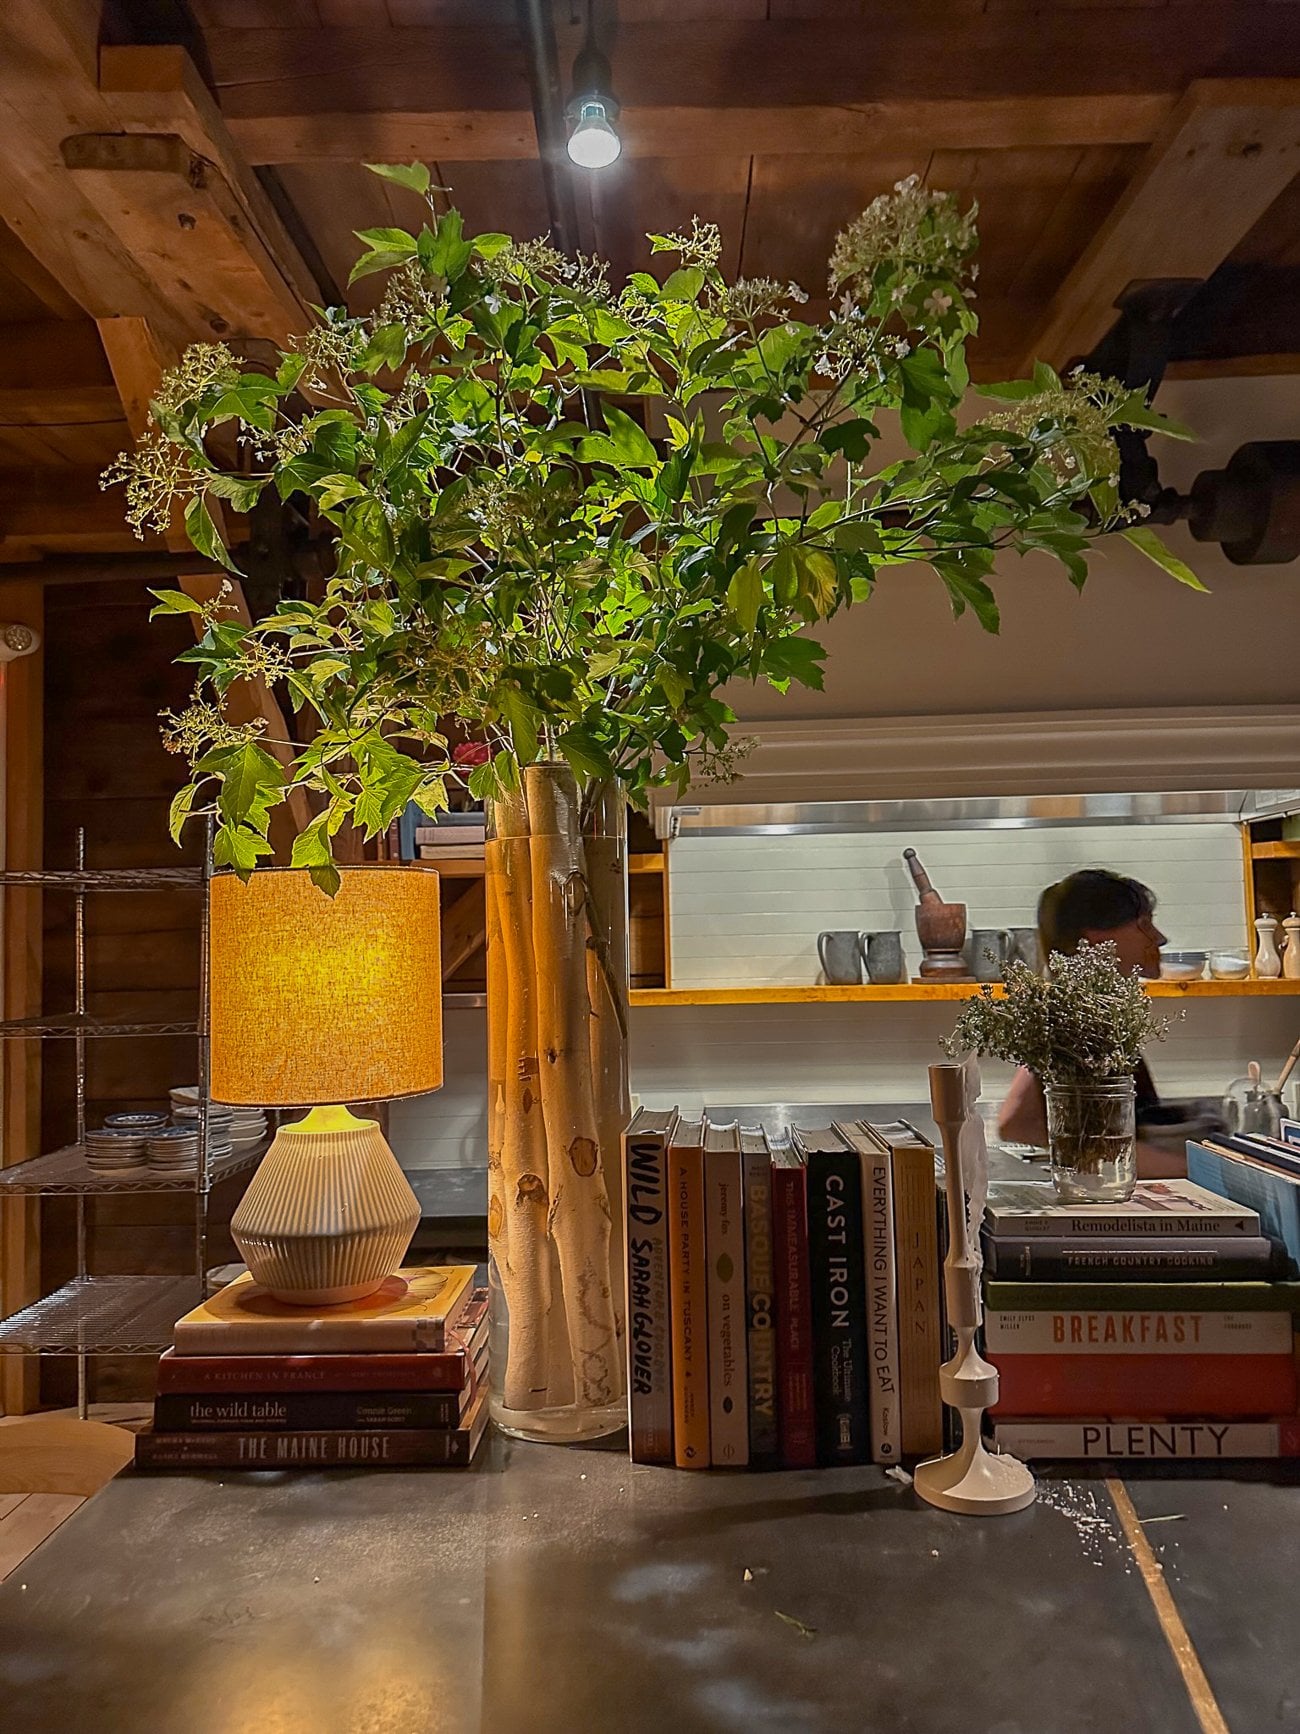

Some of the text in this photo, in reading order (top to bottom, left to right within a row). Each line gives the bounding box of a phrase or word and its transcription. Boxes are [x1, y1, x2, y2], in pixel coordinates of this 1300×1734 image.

[630, 1143, 662, 1226] WILD
[718, 1182, 730, 1236] jeremy fox
[751, 1184, 771, 1288] BASQUE
[873, 1167, 887, 1271] EVERYTHING
[1071, 1219, 1221, 1232] Remodelista in Maine
[631, 1237, 652, 1309] SARAH
[680, 1167, 693, 1363] A HOUSE PARTY IN TUSCANY
[825, 1175, 850, 1328] CAST IRON
[1068, 1256, 1214, 1266] FRENCH COUNTRY COOKING
[912, 1231, 926, 1336] JAPAN
[874, 1285, 889, 1337] WANT
[1053, 1315, 1203, 1343] BREAKFAST
[632, 1312, 654, 1395] GLOVER
[721, 1294, 735, 1387] on vegetables
[752, 1293, 774, 1416] COUNTRY
[842, 1338, 852, 1358] The
[875, 1340, 888, 1361] TO
[213, 1372, 262, 1381] KITCHEN
[267, 1371, 279, 1380] IN
[282, 1370, 325, 1380] FRANCE
[831, 1345, 842, 1396] Cookbook
[877, 1366, 895, 1394] EAT
[190, 1401, 287, 1418] the wild table
[387, 1406, 412, 1415] Green
[238, 1436, 390, 1459] THE MAINE HOUSE
[1083, 1427, 1229, 1456] PLENTY
